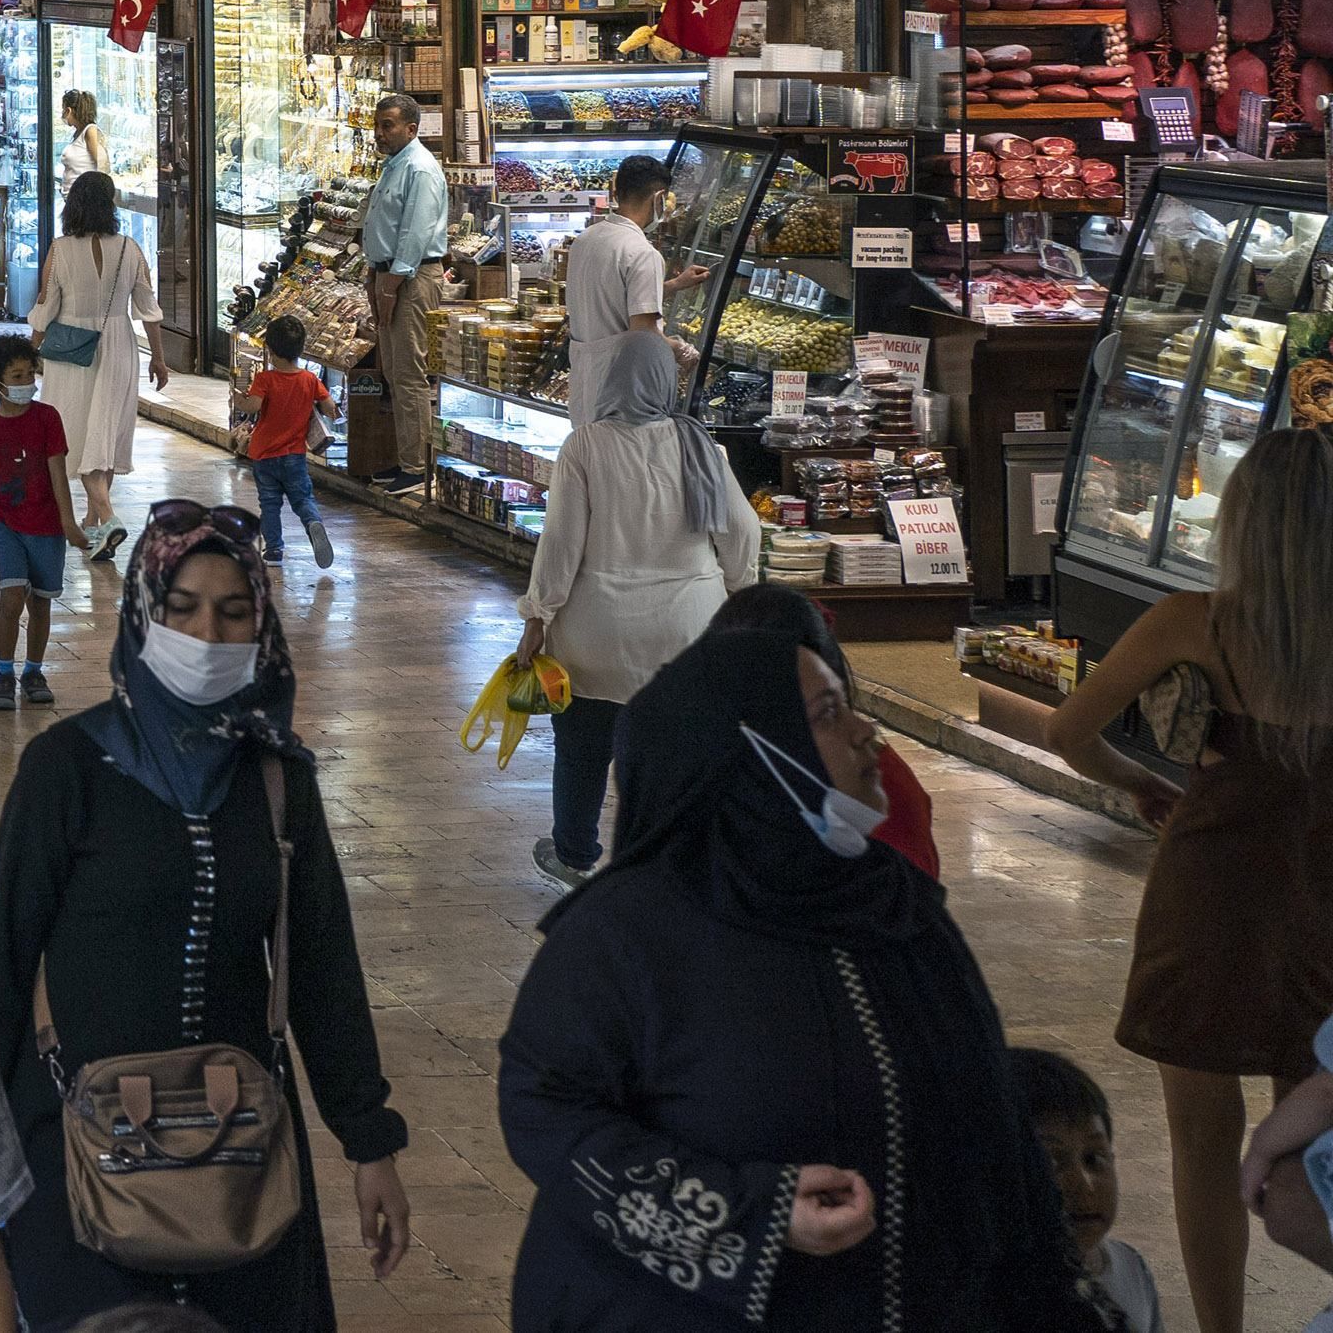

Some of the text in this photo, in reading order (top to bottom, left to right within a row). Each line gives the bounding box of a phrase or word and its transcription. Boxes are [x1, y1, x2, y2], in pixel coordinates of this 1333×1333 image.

[883, 246, 904, 255] packing
[884, 340, 922, 355] MEKLİK
[888, 359, 920, 373] TIRMA
[904, 503, 939, 516] KURU
[899, 522, 957, 534] PATLICAN
[915, 540, 949, 555] BİBER
[931, 562, 961, 575] 12.00 TL
